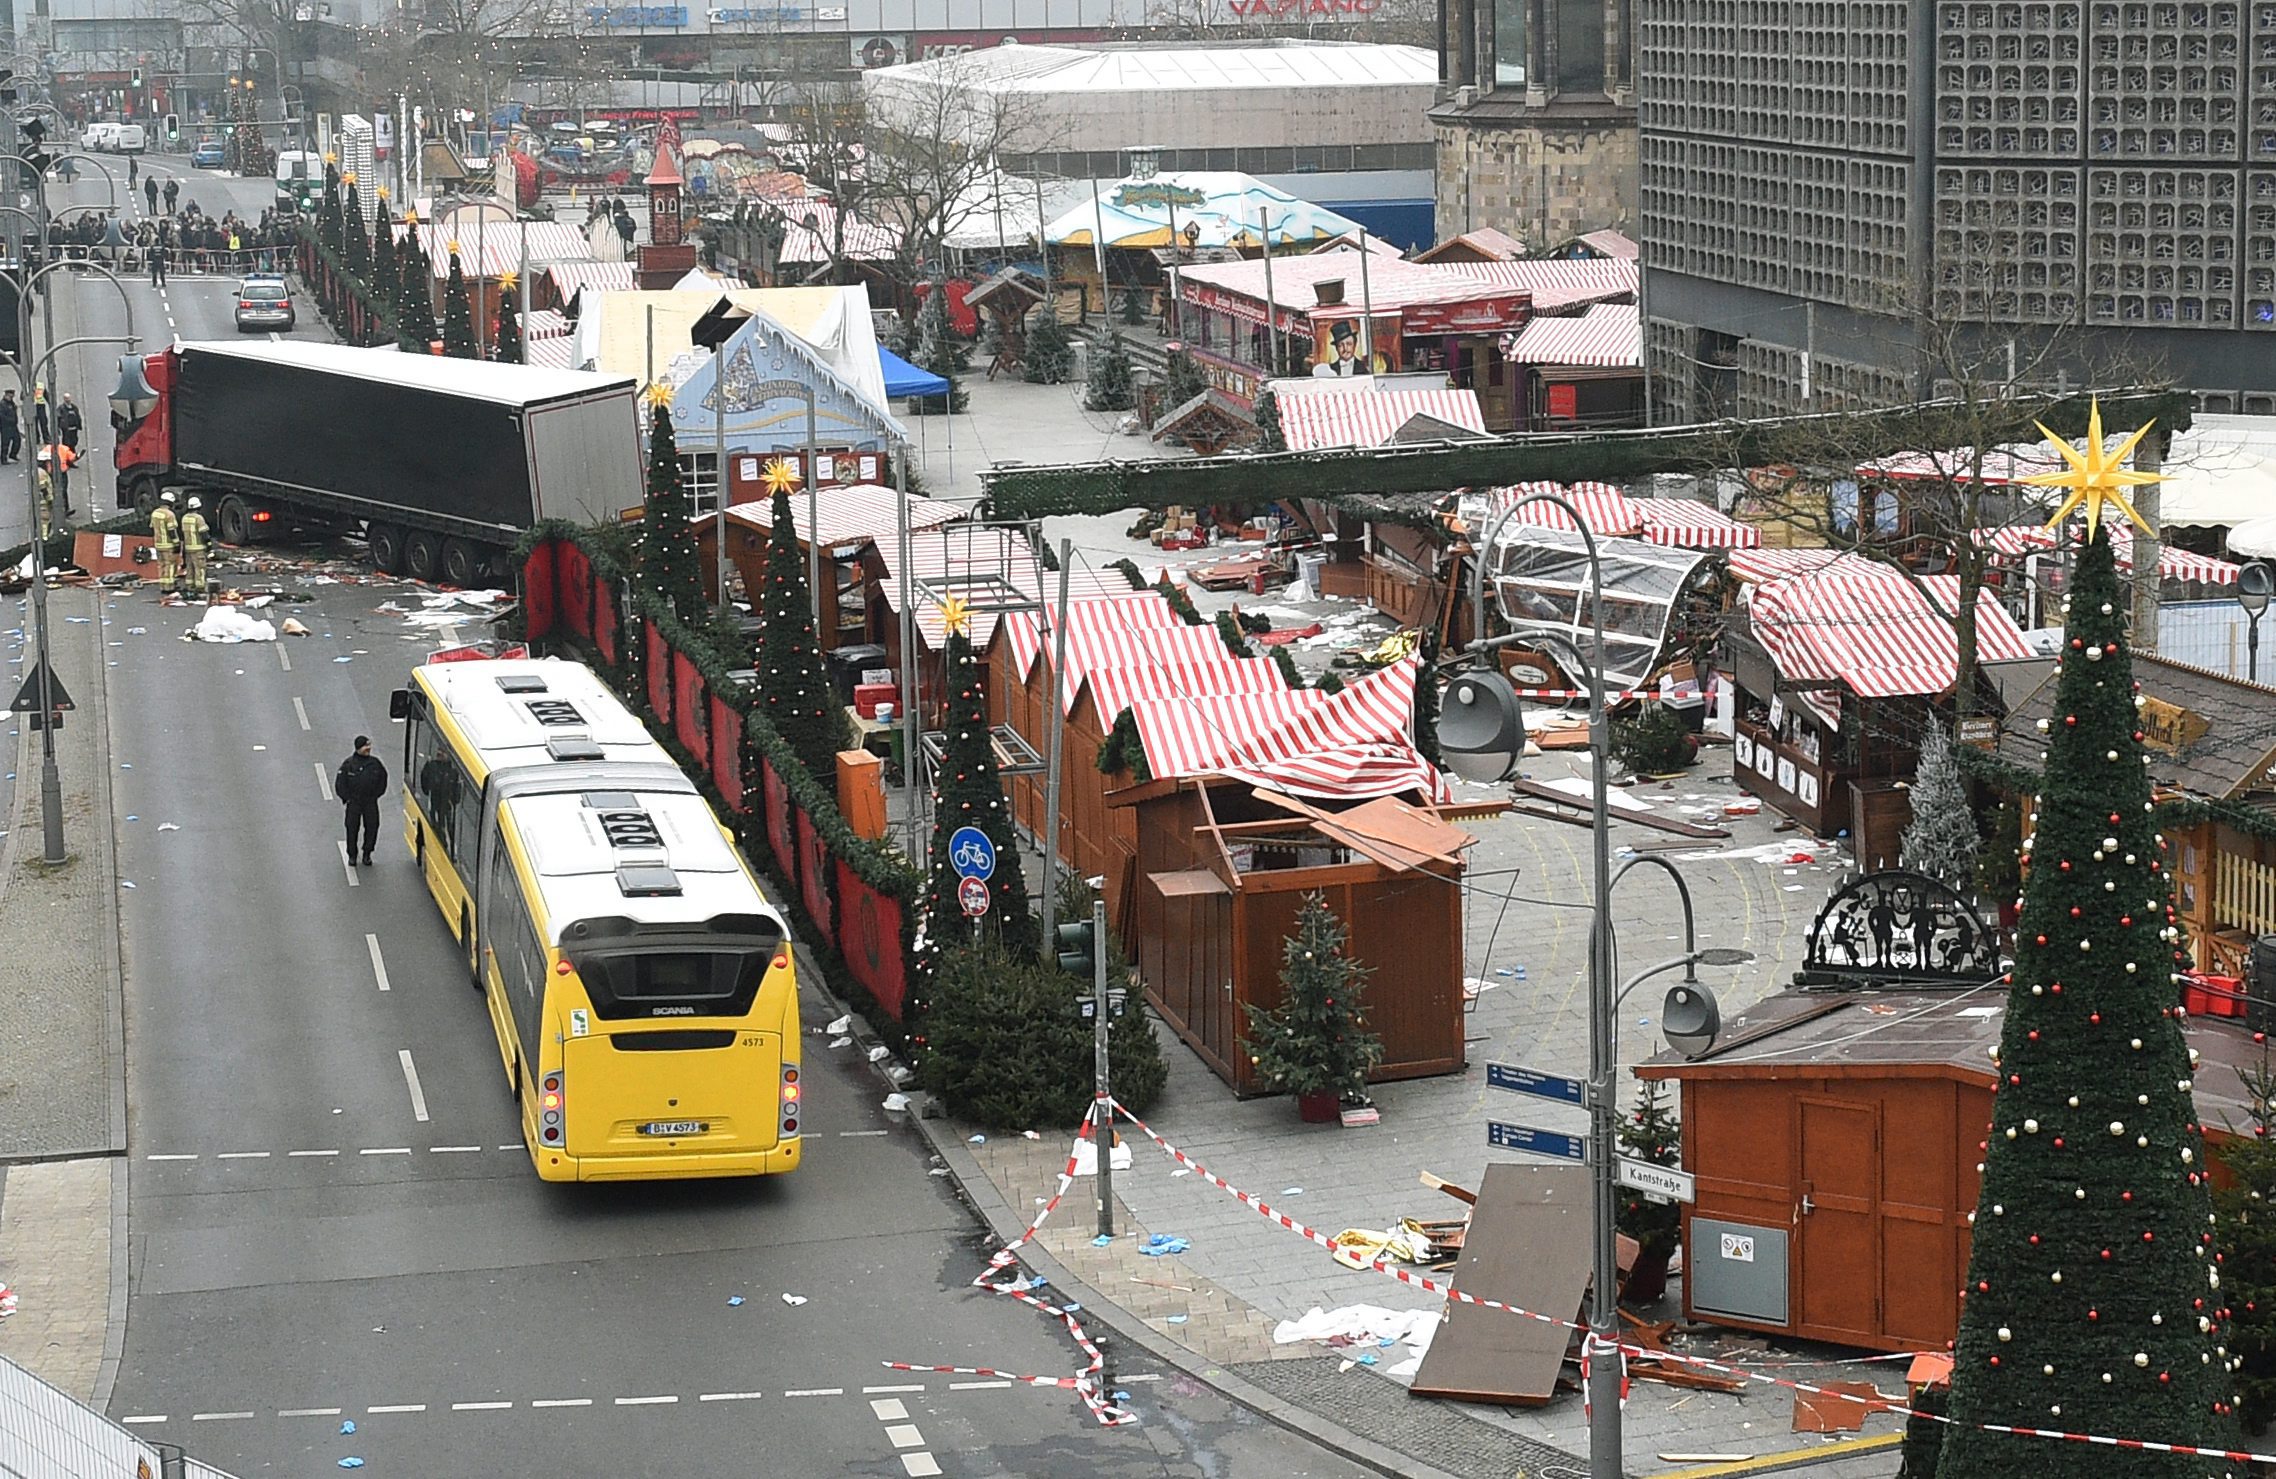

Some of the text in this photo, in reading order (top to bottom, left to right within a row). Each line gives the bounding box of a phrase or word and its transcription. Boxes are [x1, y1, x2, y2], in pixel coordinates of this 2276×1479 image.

[653, 1007, 695, 1015] SCANIA
[742, 1038, 764, 1047] 4573
[673, 1123, 697, 1132] 4573
[1630, 1167, 1681, 1192] Kantstraße
